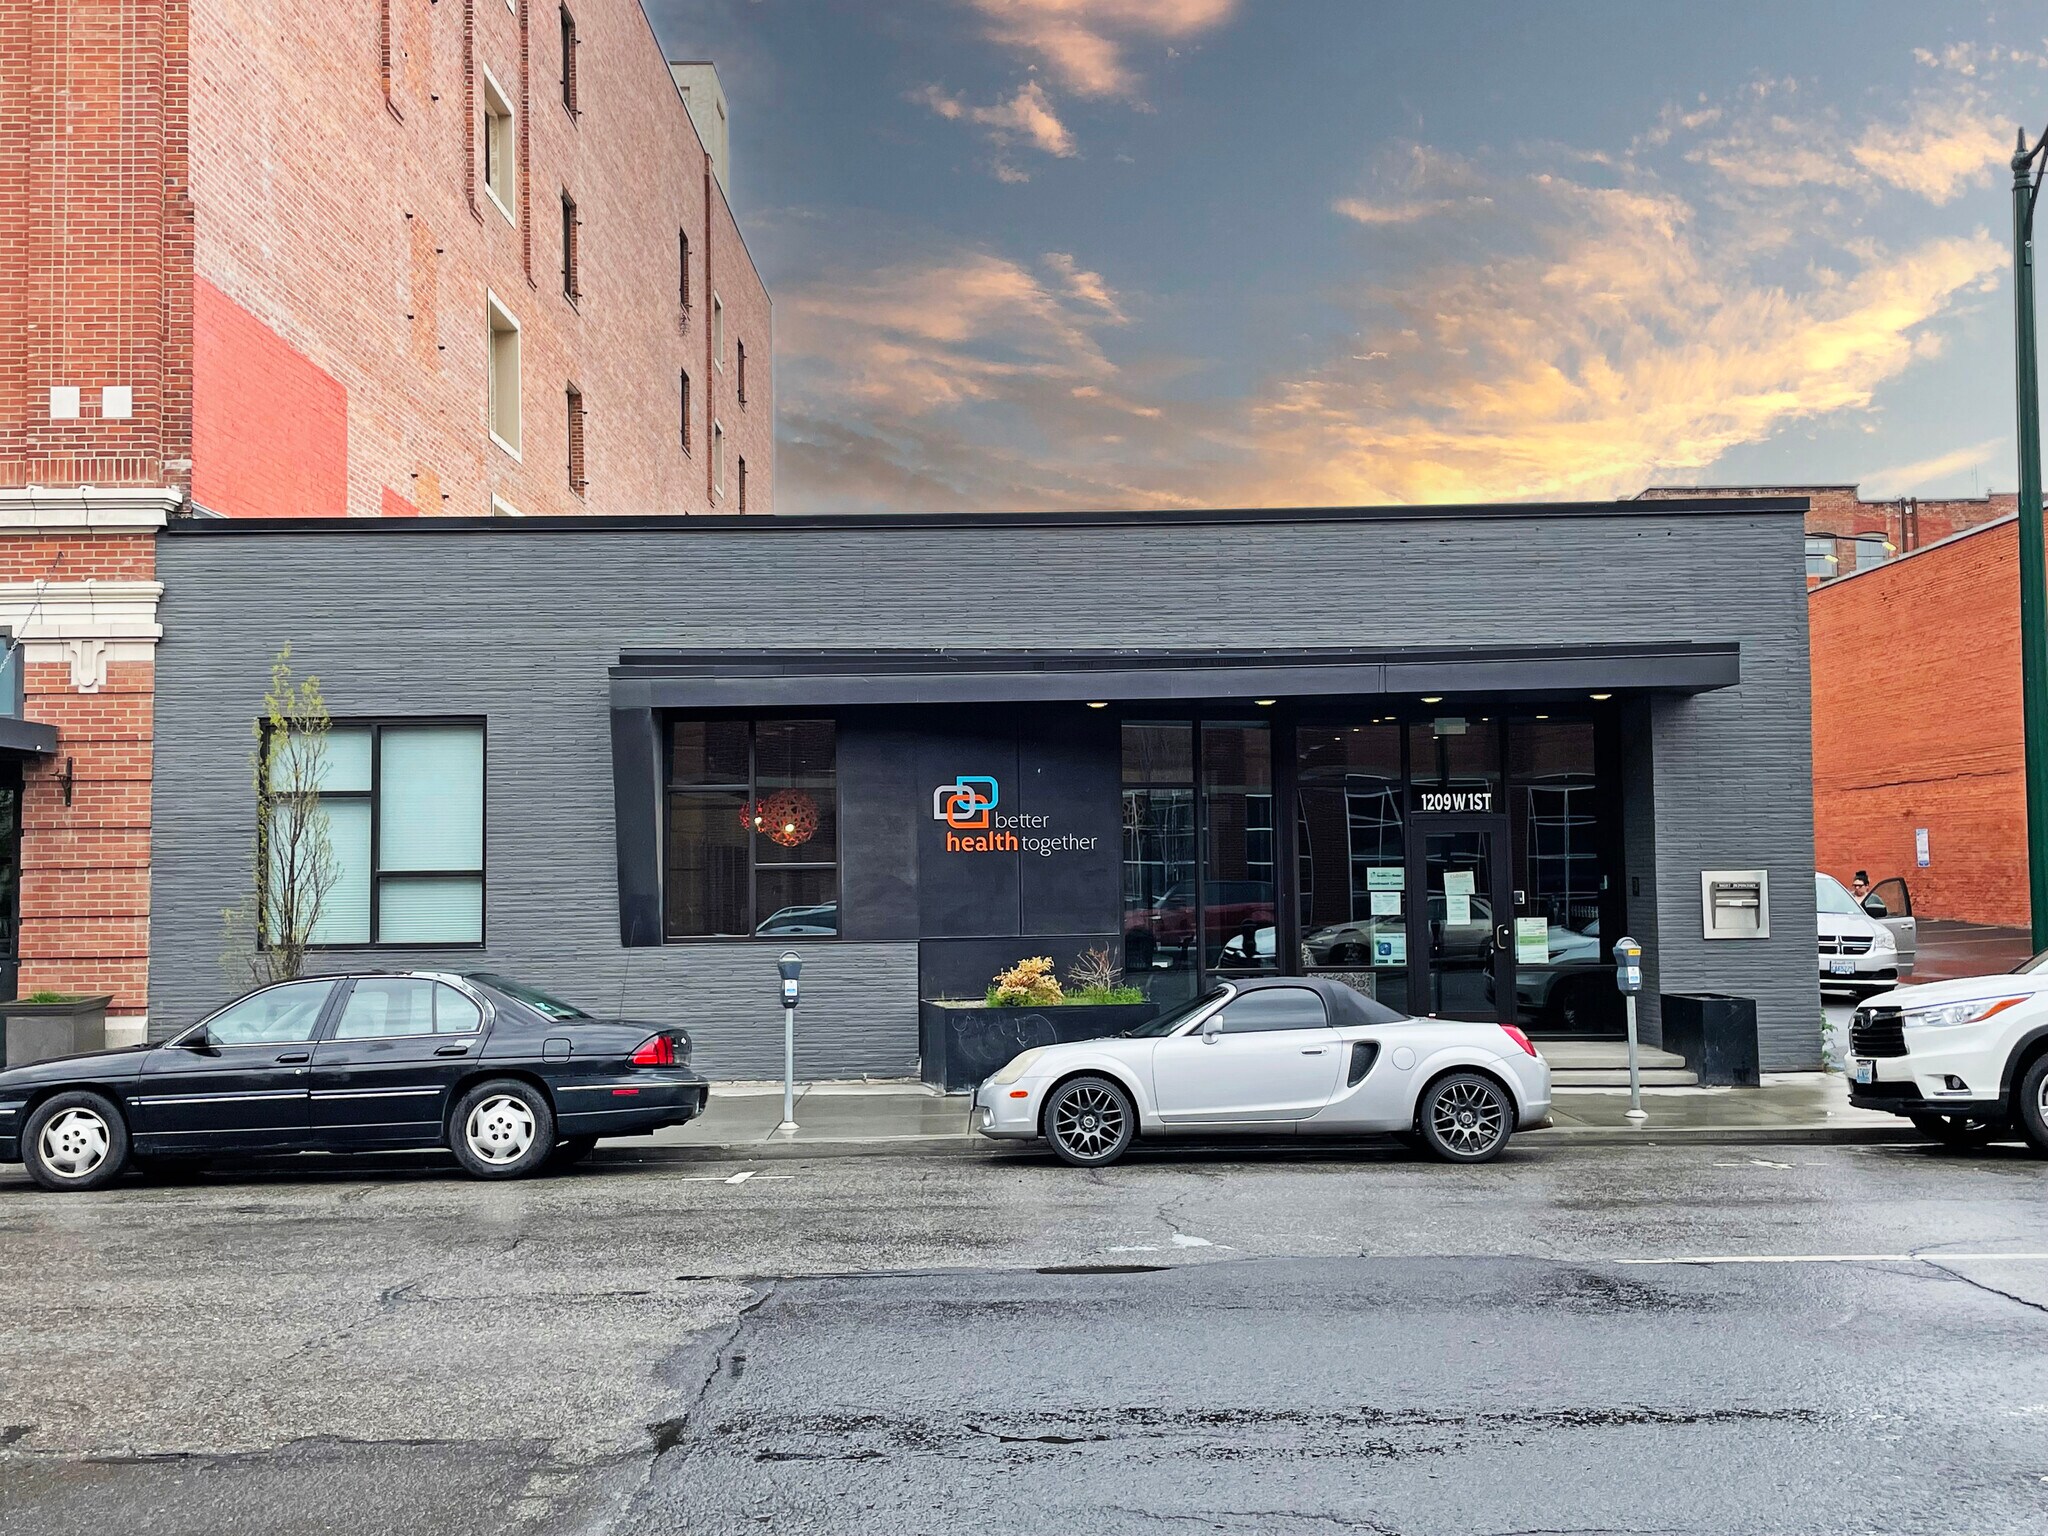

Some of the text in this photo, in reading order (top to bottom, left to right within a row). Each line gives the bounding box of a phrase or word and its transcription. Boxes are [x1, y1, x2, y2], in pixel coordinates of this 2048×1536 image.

[1421, 793, 1491, 811] 1209 W 1ST
[995, 812, 1049, 829] better
[946, 831, 1097, 857] health together
